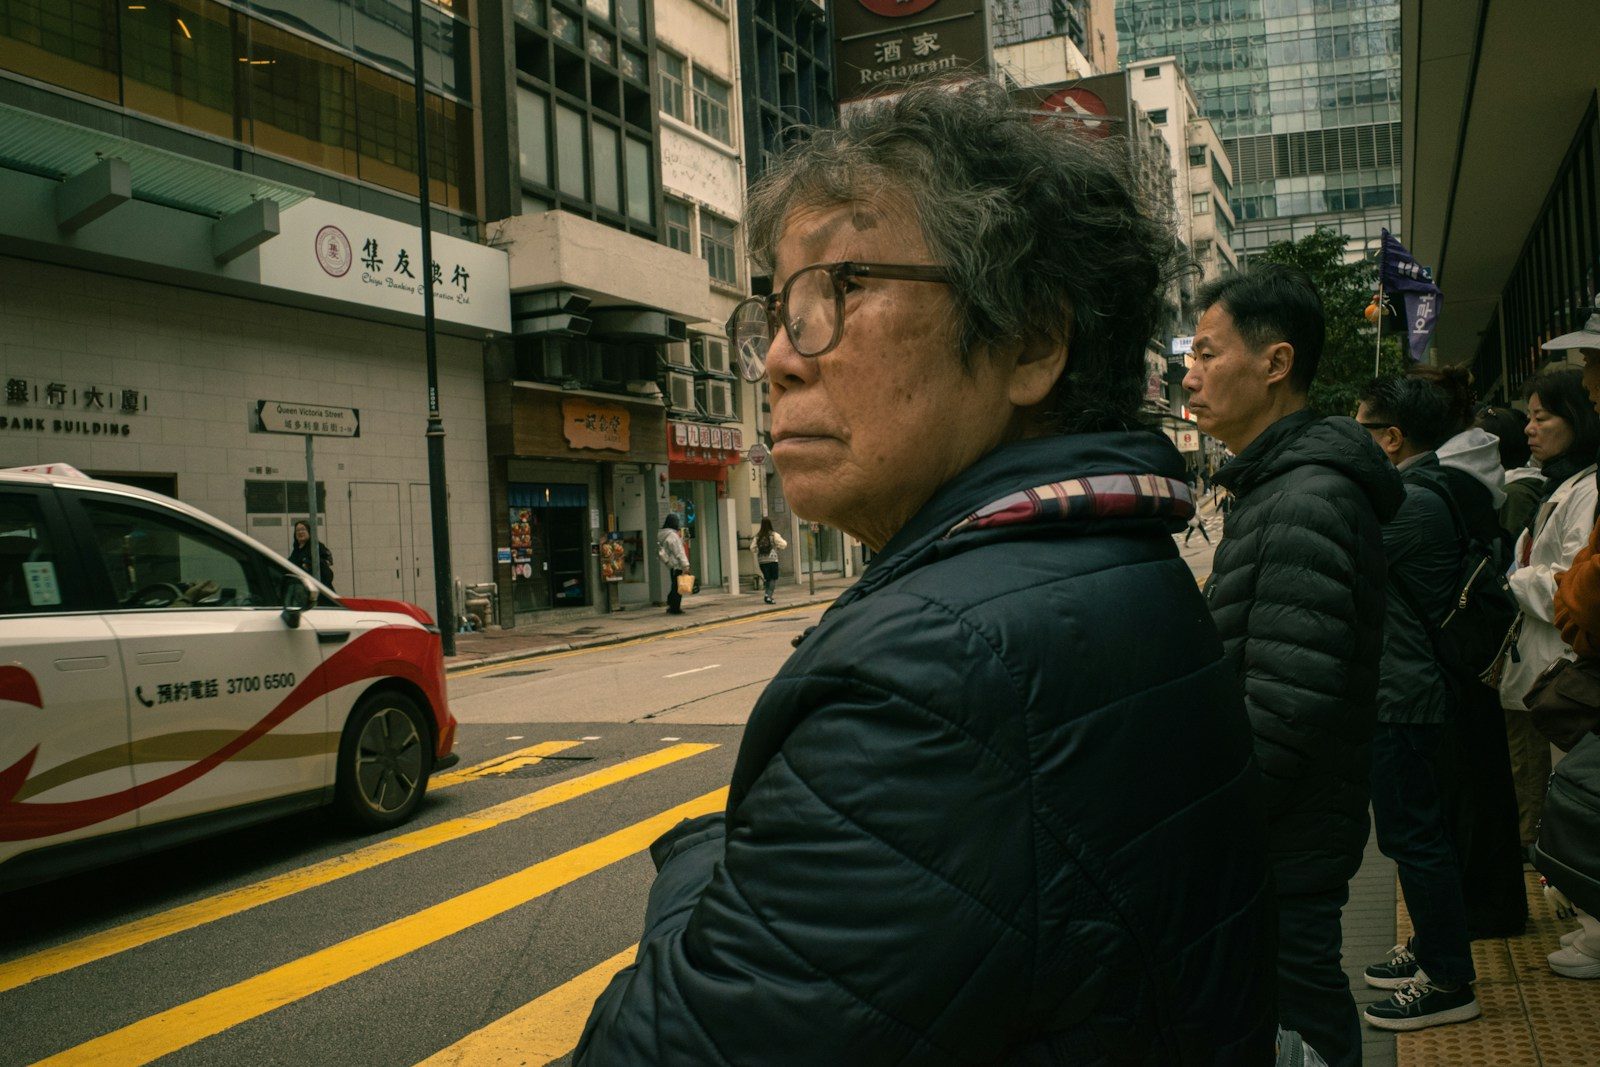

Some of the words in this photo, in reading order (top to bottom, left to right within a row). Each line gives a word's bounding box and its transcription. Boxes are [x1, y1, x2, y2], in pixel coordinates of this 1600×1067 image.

[874, 32, 941, 63] 酒家
[860, 54, 957, 84] Restaurant
[361, 272, 383, 287] Chiyu
[385, 277, 415, 295] Banking
[276, 404, 298, 415] Queen
[299, 407, 323, 418] Victoria
[324, 409, 344, 418] Street
[0, 416, 45, 431] BANK
[53, 420, 130, 436] BUILDING
[157, 678, 219, 704] 預約電話
[227, 676, 260, 694] 3700
[264, 672, 296, 690] 6500
